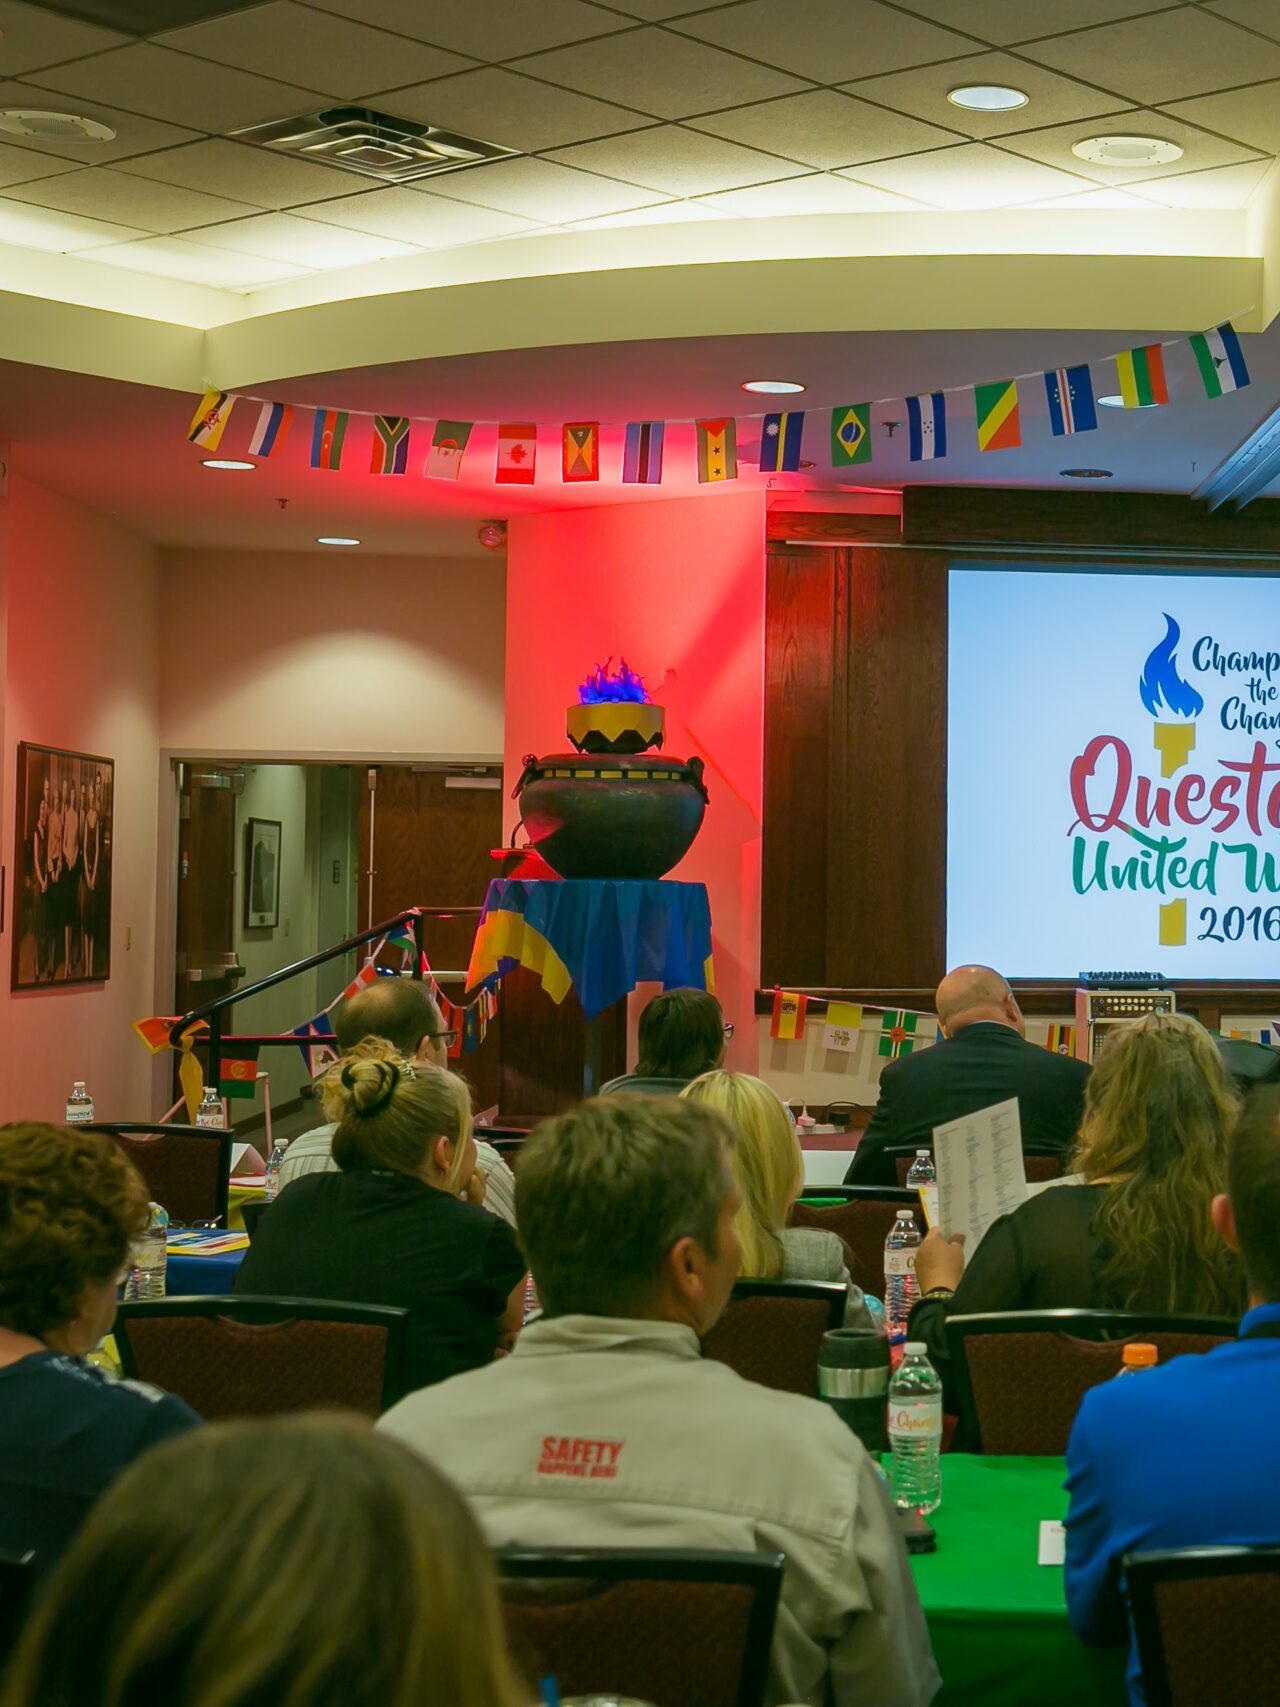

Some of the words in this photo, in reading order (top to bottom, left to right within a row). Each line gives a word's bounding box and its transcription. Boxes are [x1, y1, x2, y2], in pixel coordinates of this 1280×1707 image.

[1245, 677, 1279, 705] the
[1072, 835, 1219, 895] United
[542, 1436, 625, 1463] SAFETY
